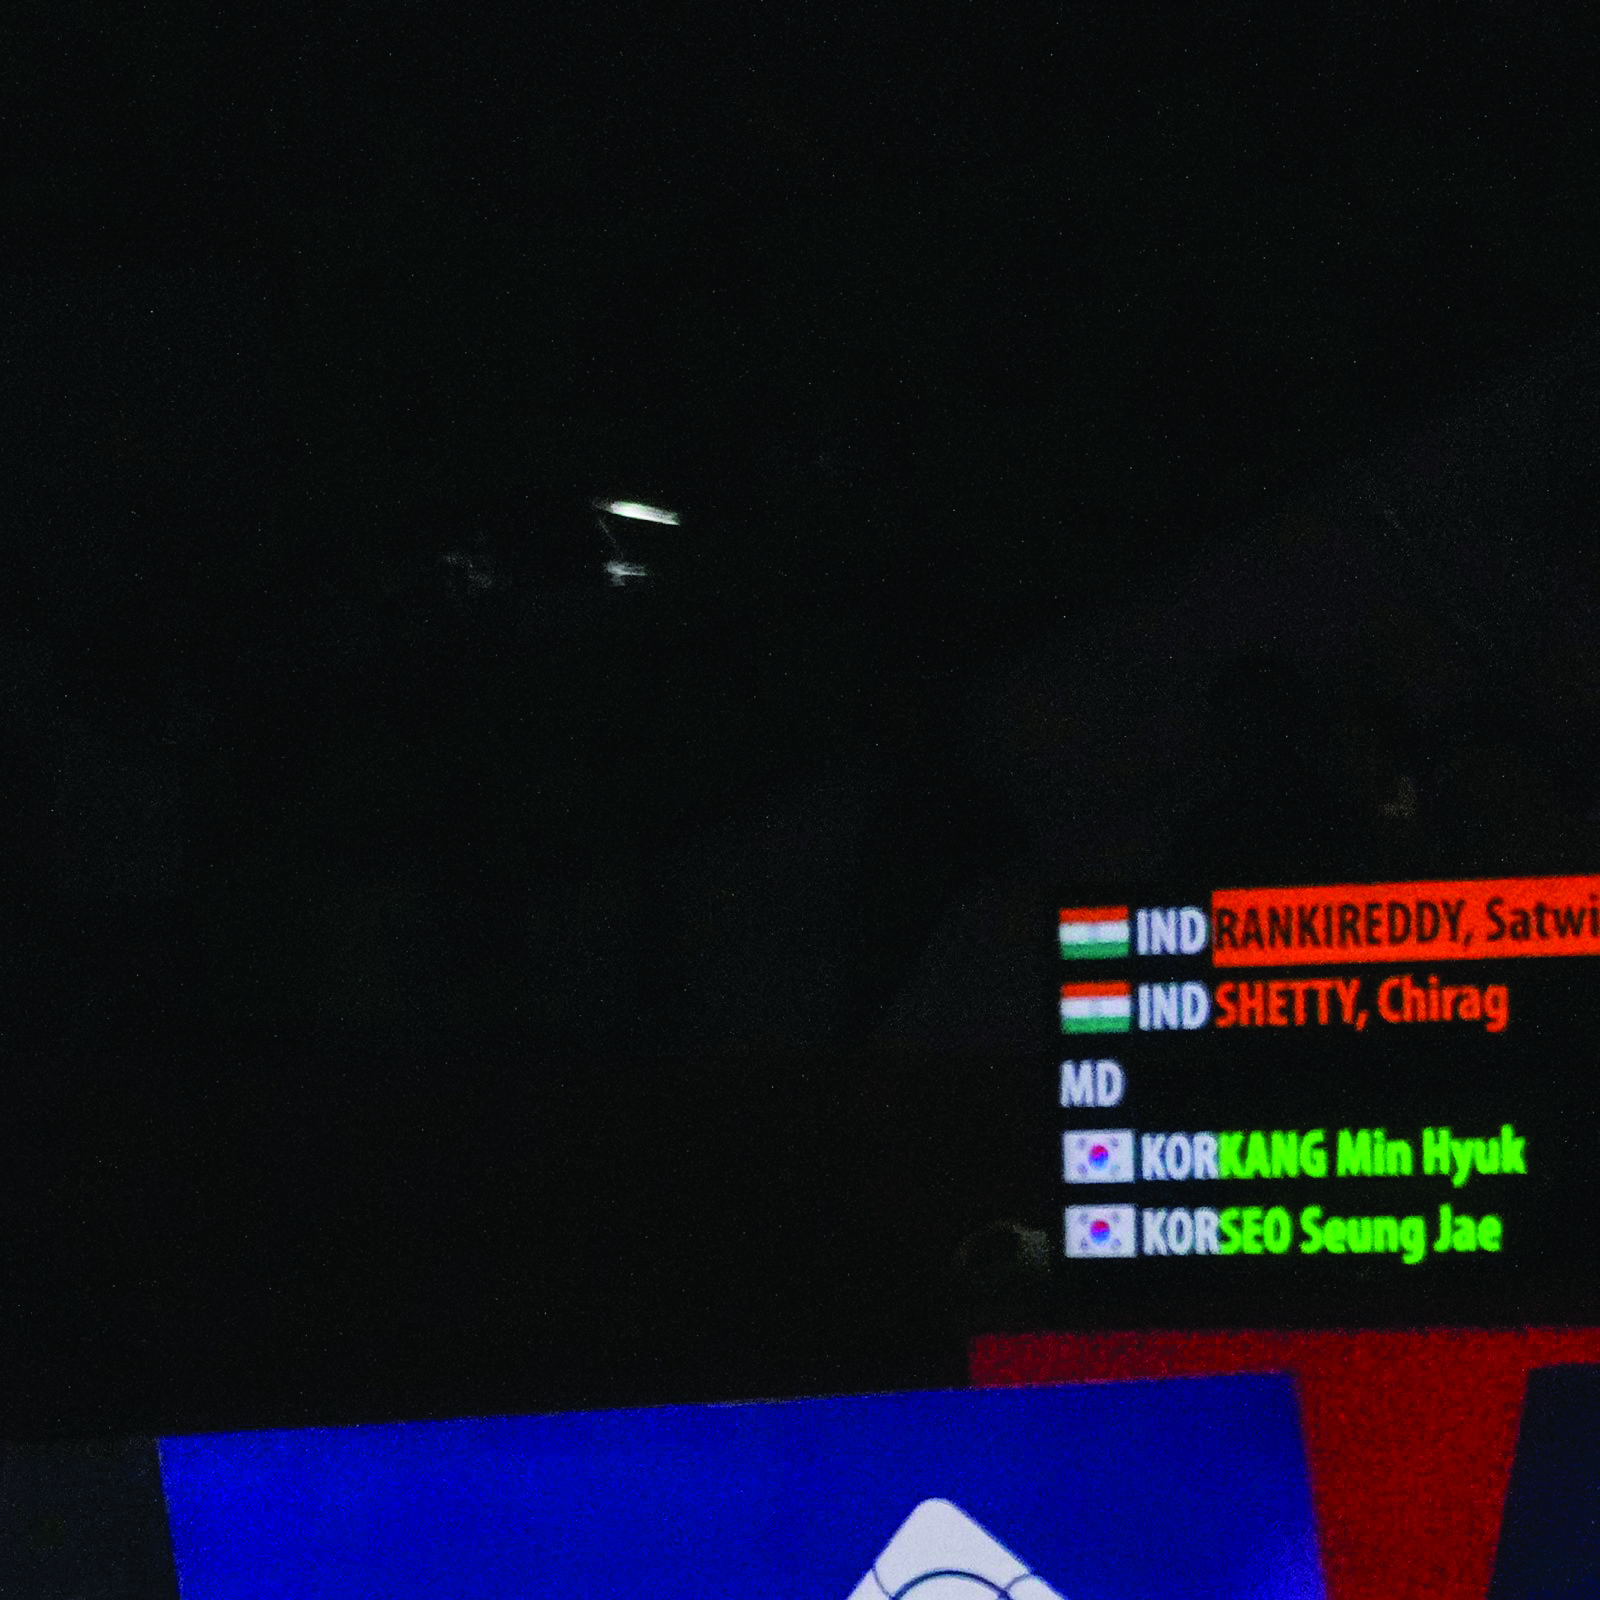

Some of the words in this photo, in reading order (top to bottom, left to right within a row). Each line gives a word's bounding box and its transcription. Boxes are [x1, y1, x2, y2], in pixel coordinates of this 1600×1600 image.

[1136, 906, 1209, 956] IND
[1216, 899, 1472, 949] RANKIREDDY,
[1485, 892, 1600, 942] Satwi
[1137, 981, 1210, 1031] IND
[1215, 977, 1370, 1032] SHETTY,
[1376, 974, 1510, 1033] Chirag
[1060, 1058, 1126, 1108] MD
[1141, 1132, 1218, 1180] KOR
[1219, 1128, 1328, 1178] KANG
[1337, 1127, 1413, 1177] Min
[1422, 1123, 1528, 1188] Hyuk
[1141, 1206, 1218, 1256] KOR
[1219, 1205, 1293, 1255] SEO
[1299, 1204, 1427, 1265] Seung
[1432, 1202, 1503, 1253] Jae
